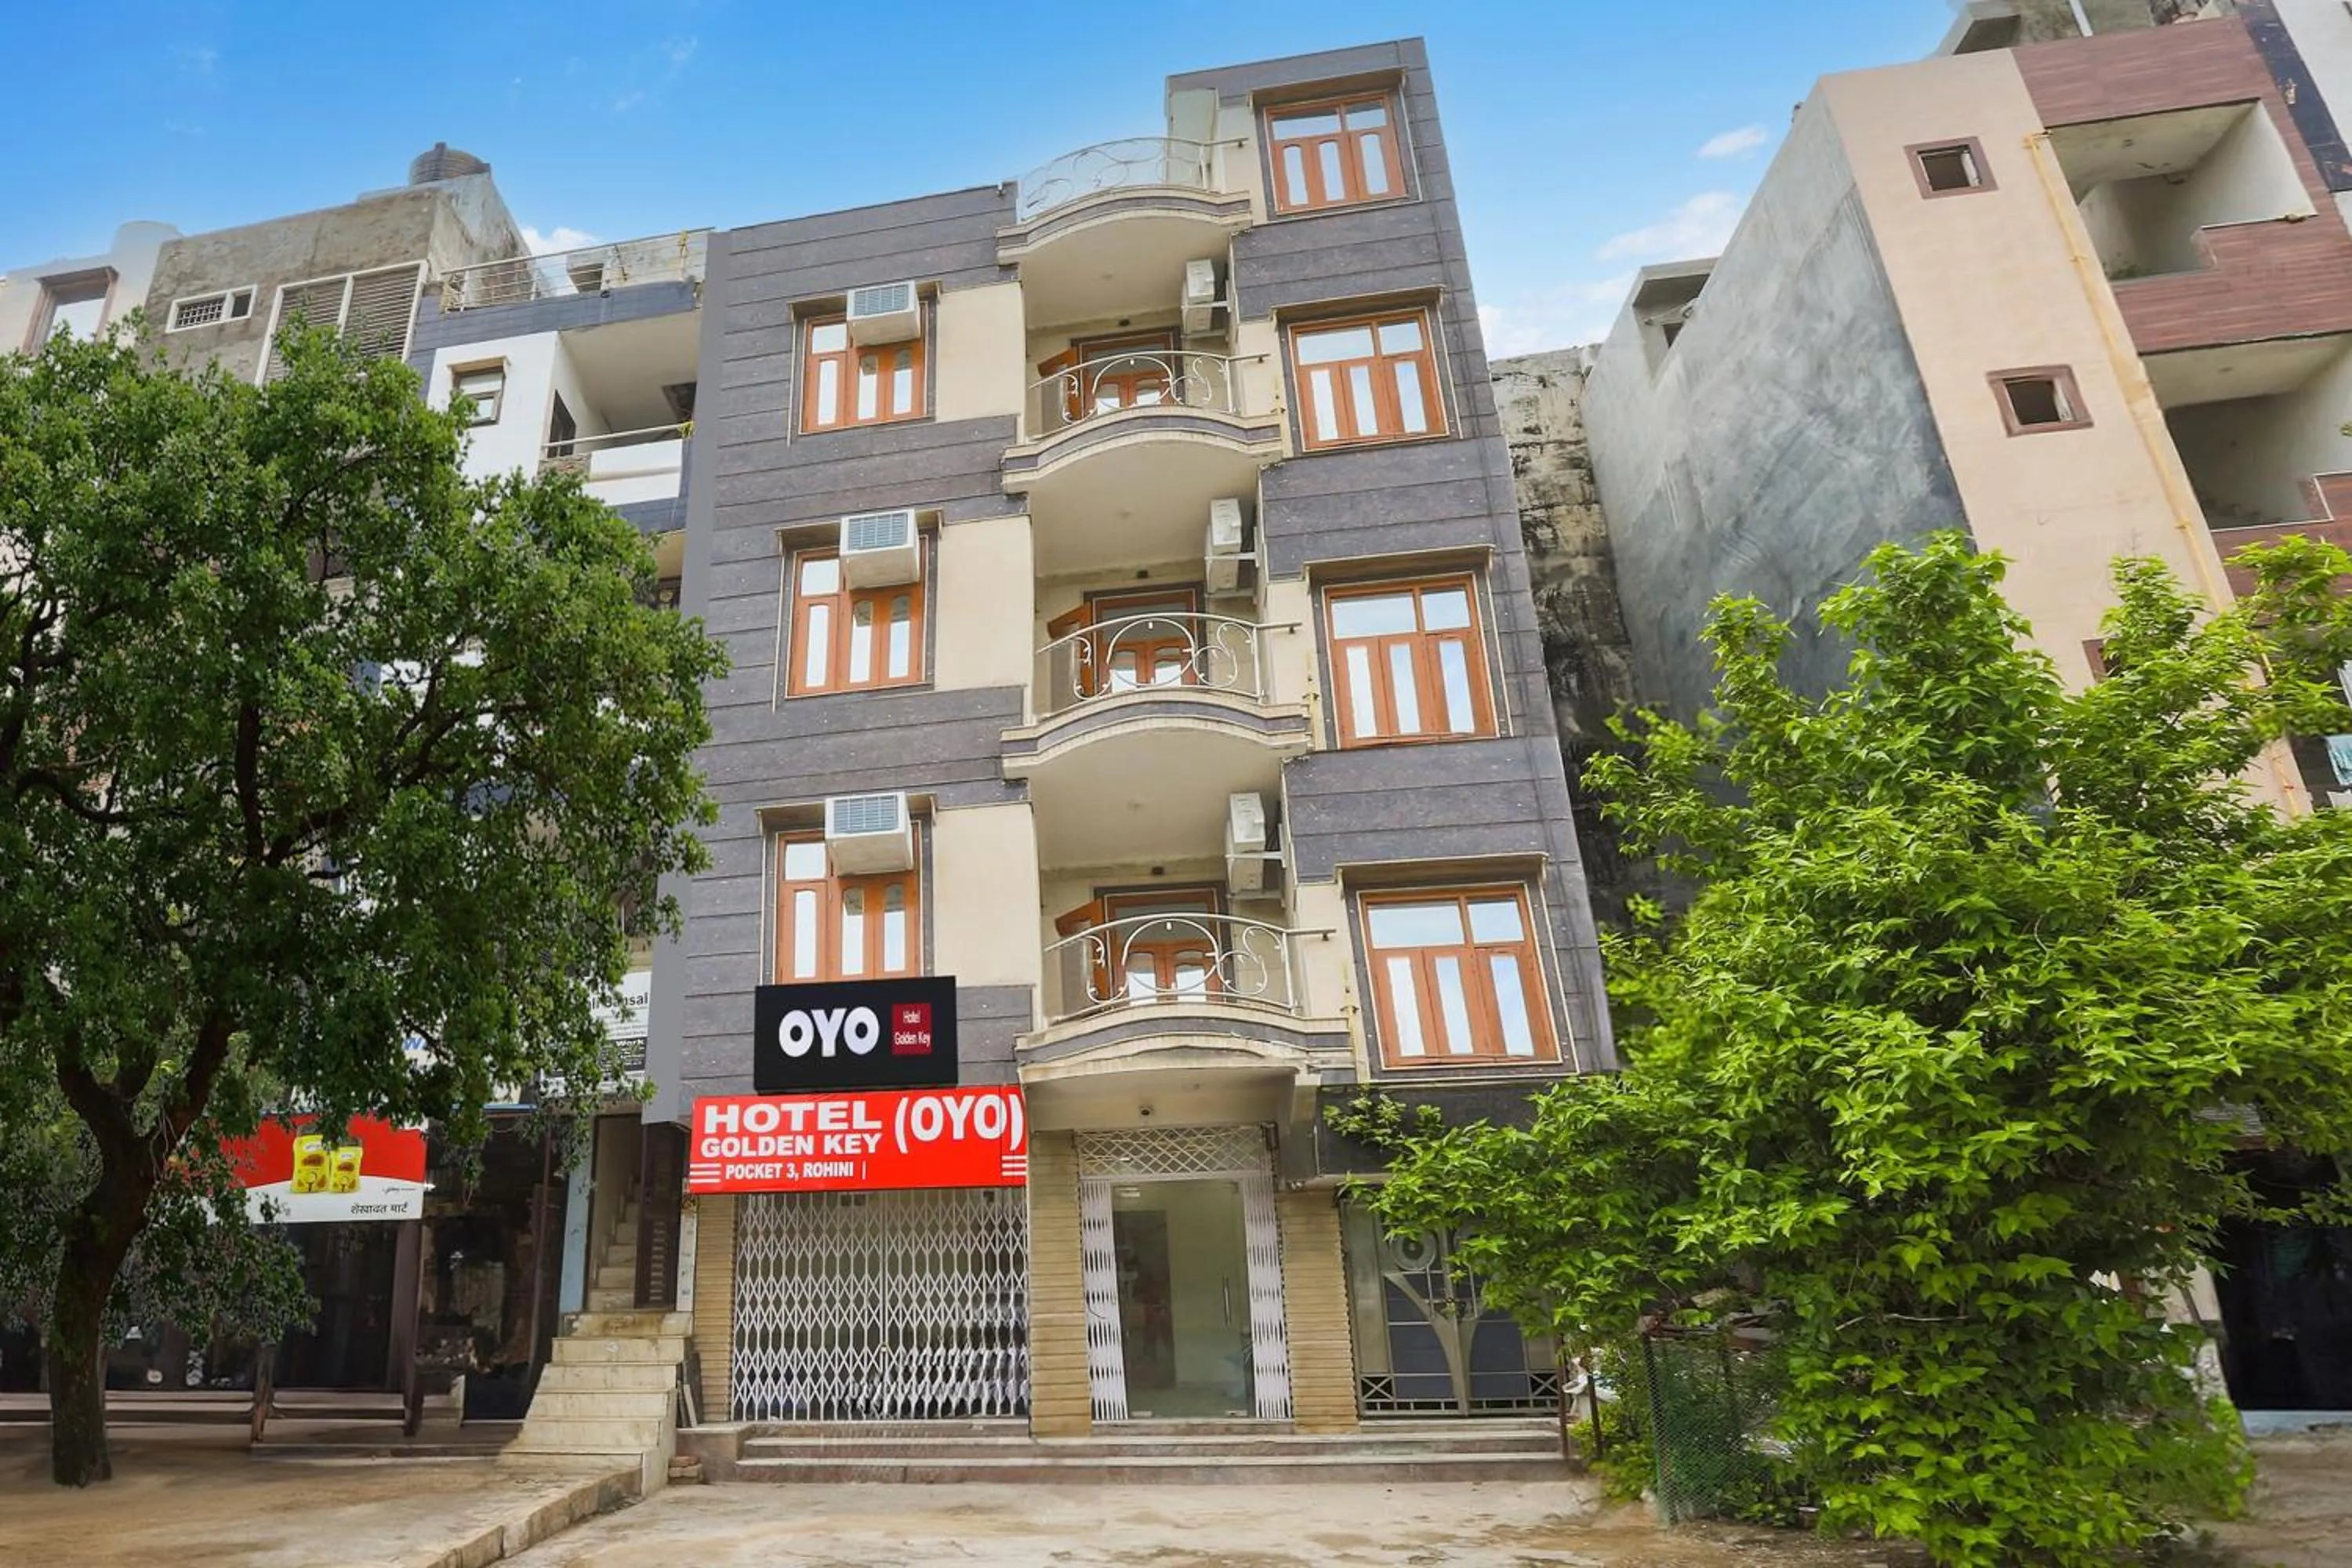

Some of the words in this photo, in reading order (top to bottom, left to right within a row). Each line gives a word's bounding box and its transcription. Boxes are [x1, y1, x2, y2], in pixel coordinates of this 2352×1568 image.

[902, 1010, 921, 1023] Hotel
[779, 1007, 879, 1057] OYO
[894, 1031, 917, 1045] Golden
[918, 1031, 931, 1047] Key
[705, 1101, 882, 1134] HOTEL
[895, 1094, 1024, 1153] (OYO)
[701, 1134, 815, 1158] GOLDEN
[823, 1133, 882, 1155] KEY
[725, 1163, 783, 1180] POCKET
[786, 1163, 799, 1181] 3,
[803, 1162, 854, 1178] ROHINI
